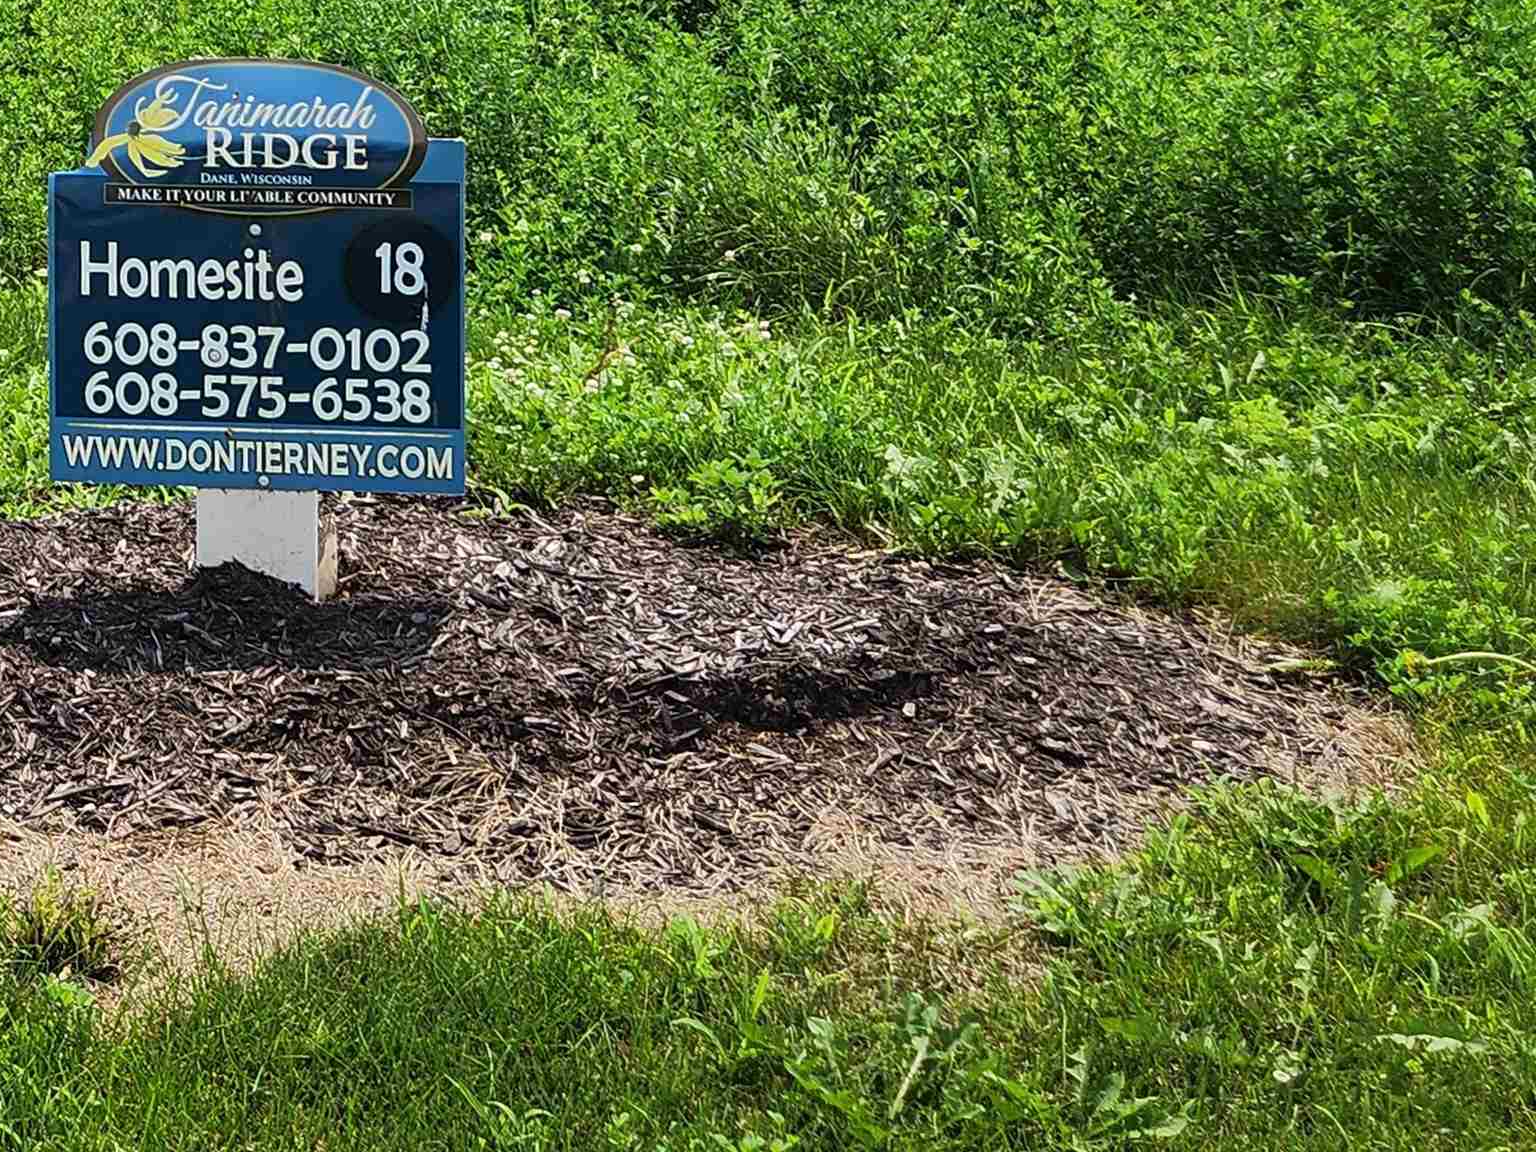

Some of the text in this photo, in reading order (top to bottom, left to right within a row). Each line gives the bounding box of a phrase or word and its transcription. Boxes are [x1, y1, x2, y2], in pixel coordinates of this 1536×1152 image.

[135, 75, 377, 131] Tanimarah
[202, 126, 369, 171] RIDGE
[117, 187, 162, 201] MAKE
[165, 188, 182, 201] IT
[183, 189, 227, 202] YOUR
[297, 191, 396, 205] COMMUNITY
[79, 240, 425, 302] Homesite 18
[83, 321, 432, 374] 608-837-0102
[84, 371, 432, 424] 608-575-6538
[62, 434, 454, 480] WWW.DONTIERNEY.COM
